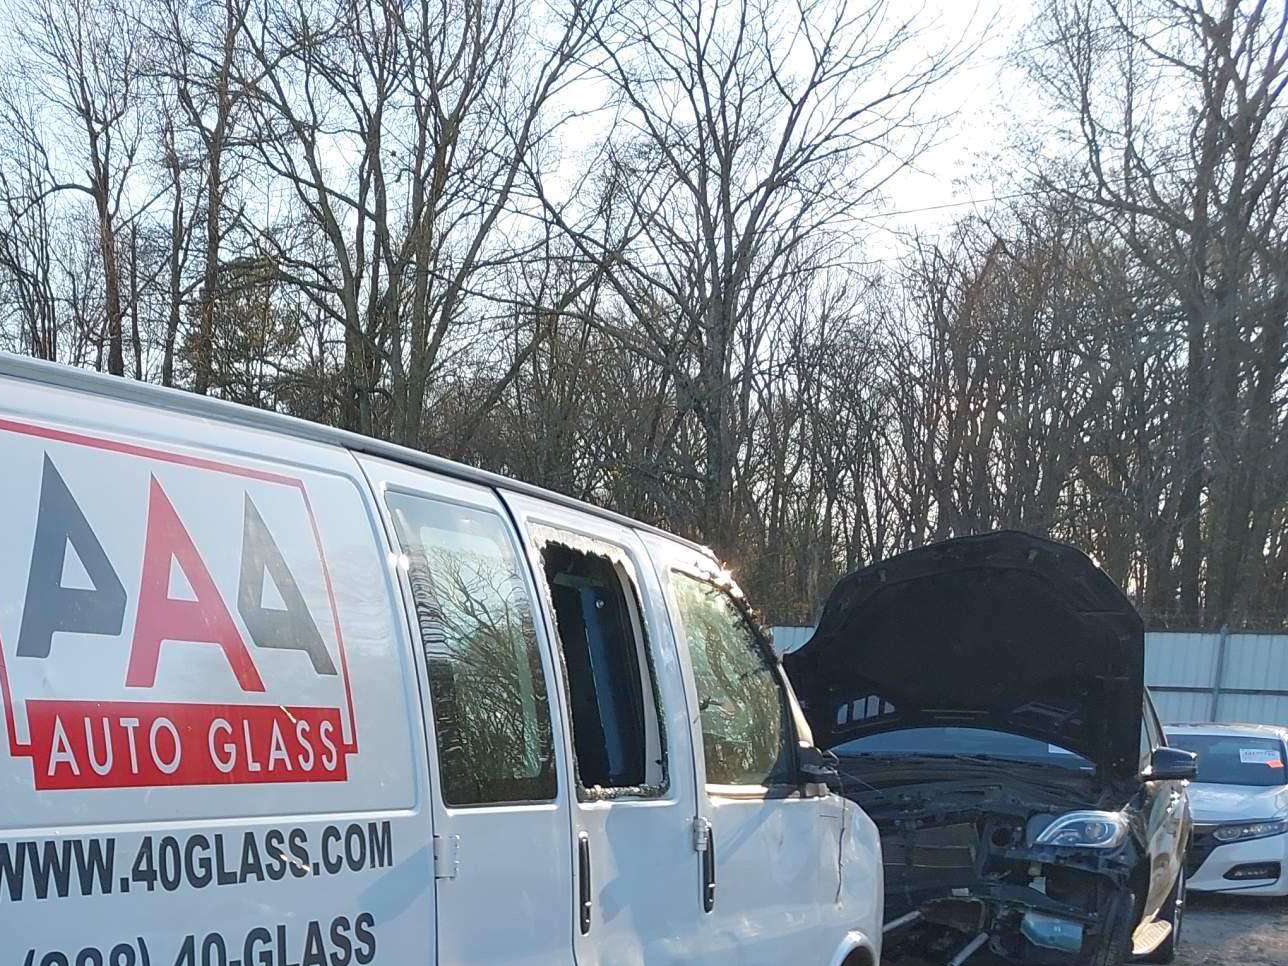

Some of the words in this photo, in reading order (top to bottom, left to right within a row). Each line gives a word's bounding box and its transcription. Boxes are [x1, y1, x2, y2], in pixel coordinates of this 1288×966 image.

[16, 450, 338, 692] AAA
[47, 715, 182, 776] AUTO
[208, 716, 338, 773] GLASS
